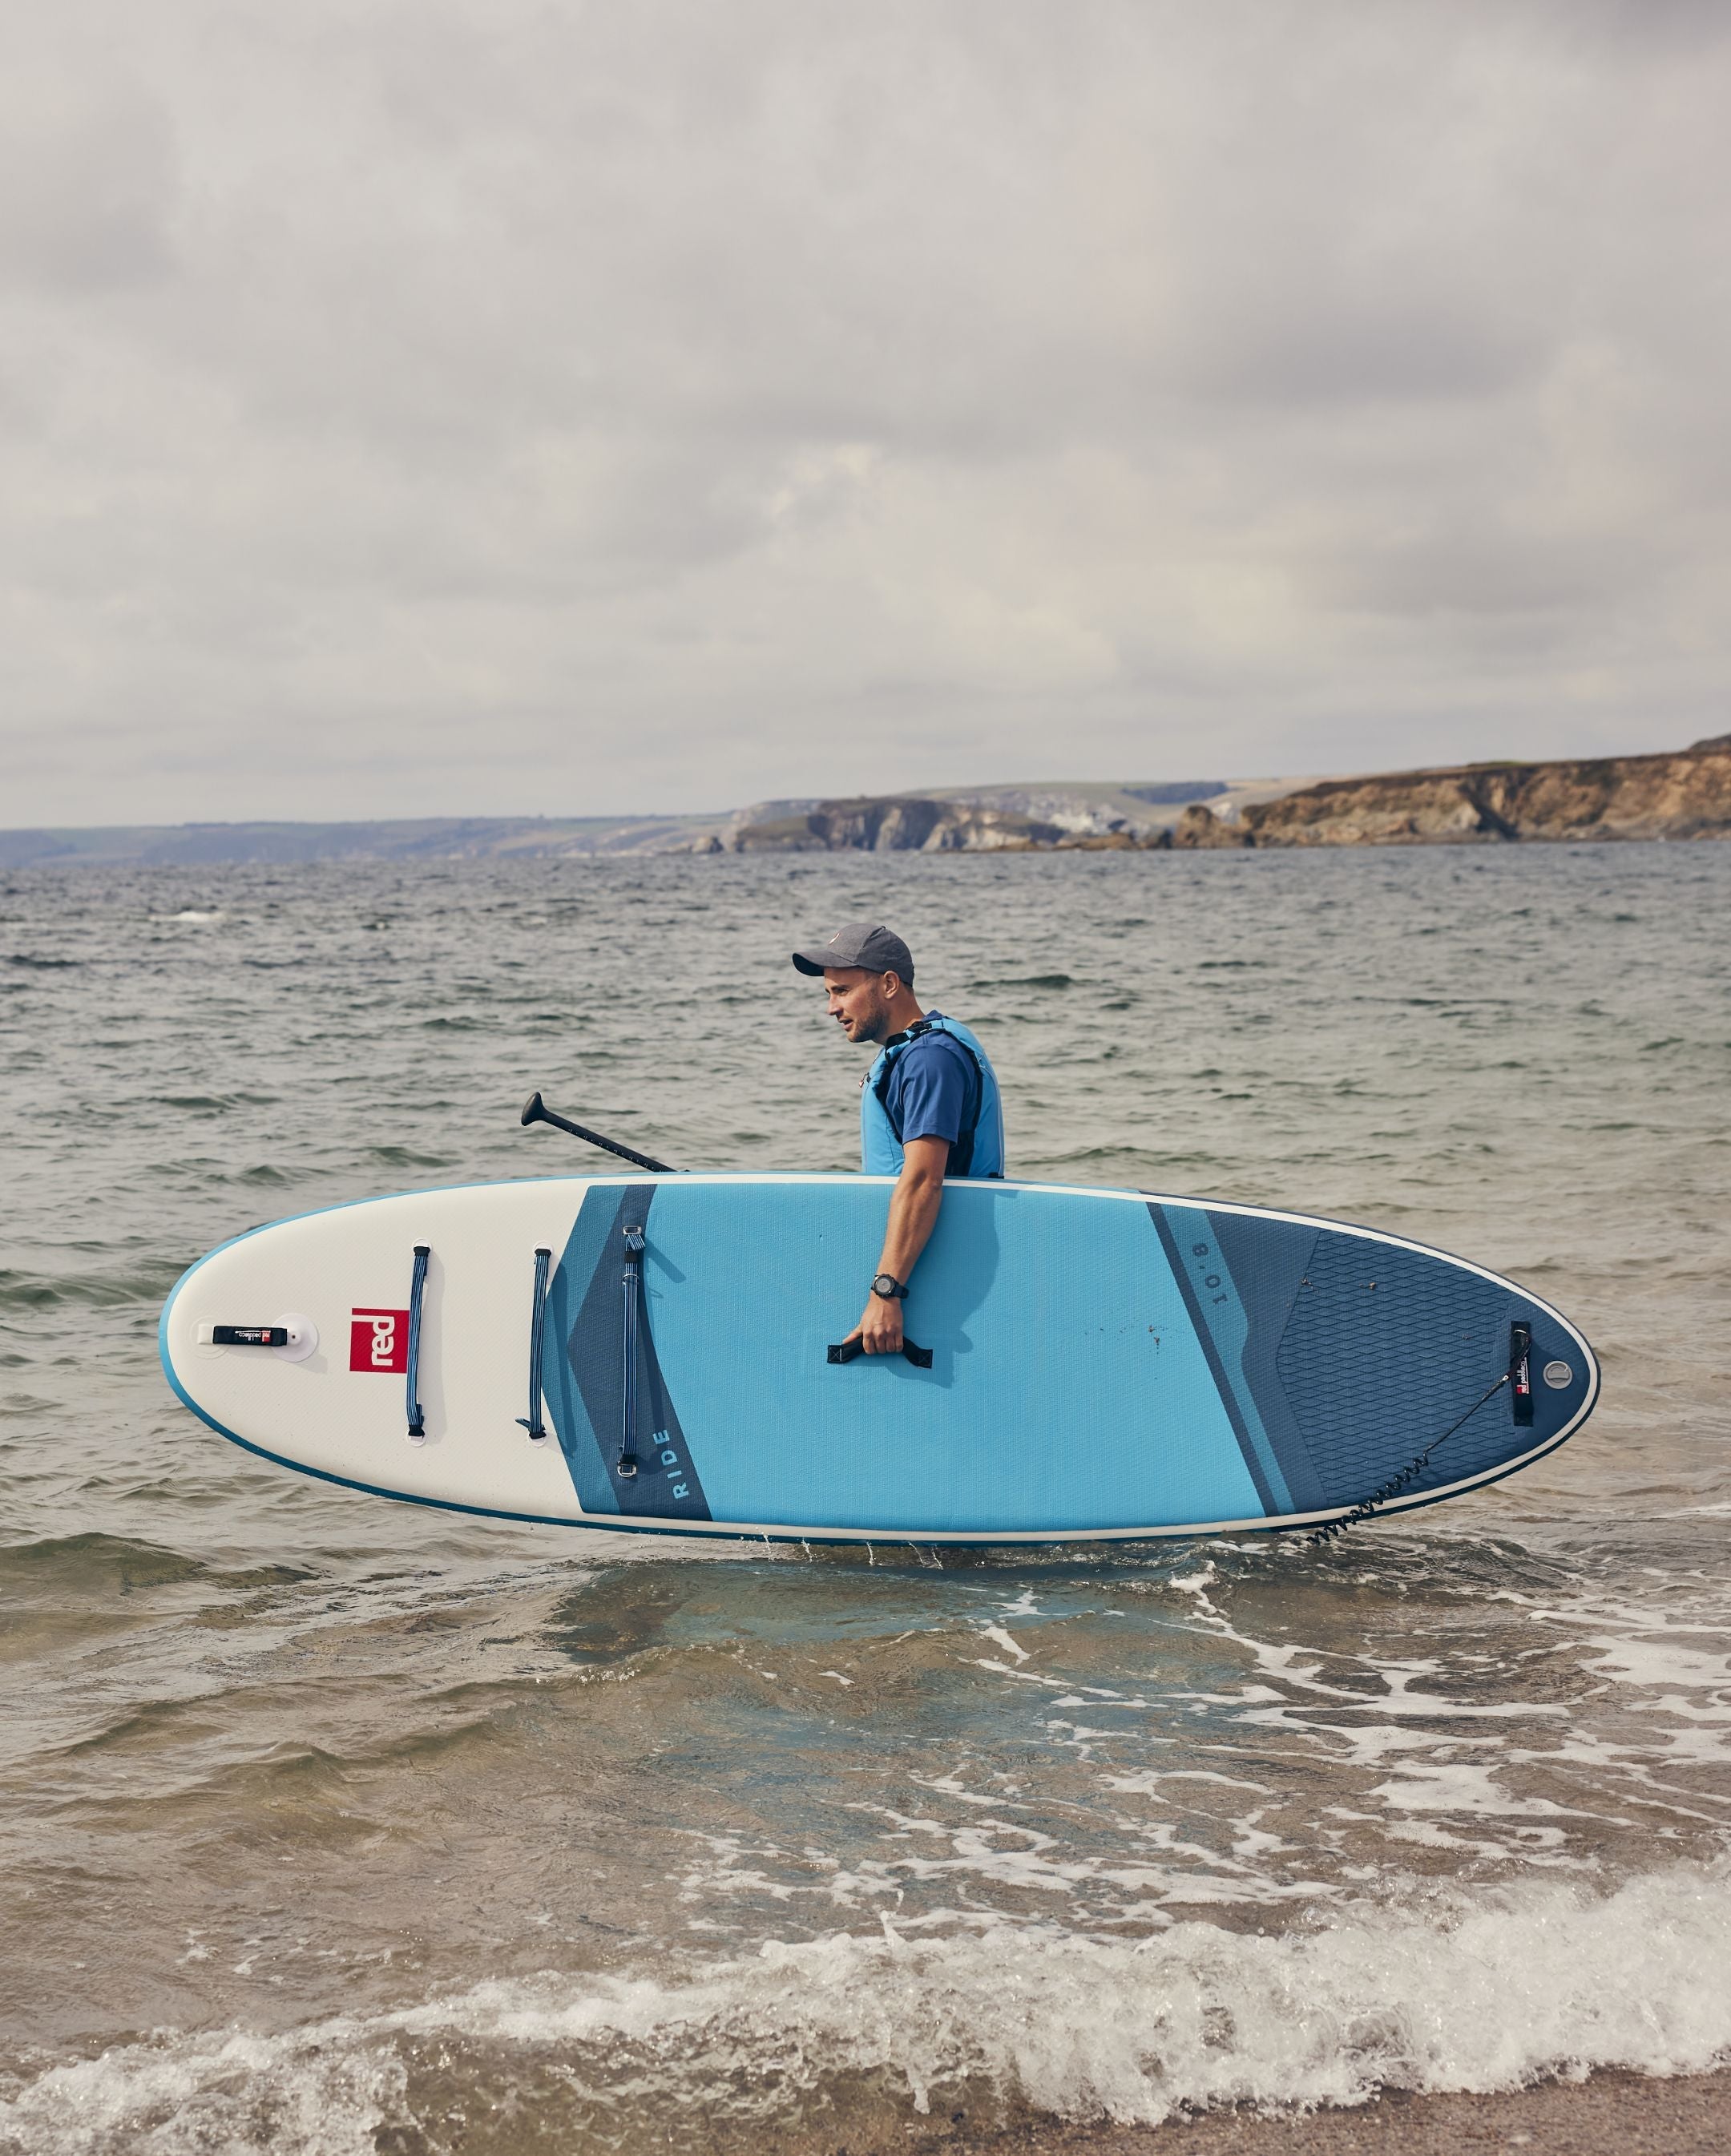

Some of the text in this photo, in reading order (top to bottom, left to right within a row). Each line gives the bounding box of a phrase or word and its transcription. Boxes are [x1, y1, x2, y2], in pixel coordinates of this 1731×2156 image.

[261, 1331, 270, 1342] red
[351, 1314, 395, 1366] red
[1516, 1384, 1527, 1393] red
[653, 1429, 689, 1500] RIDE
